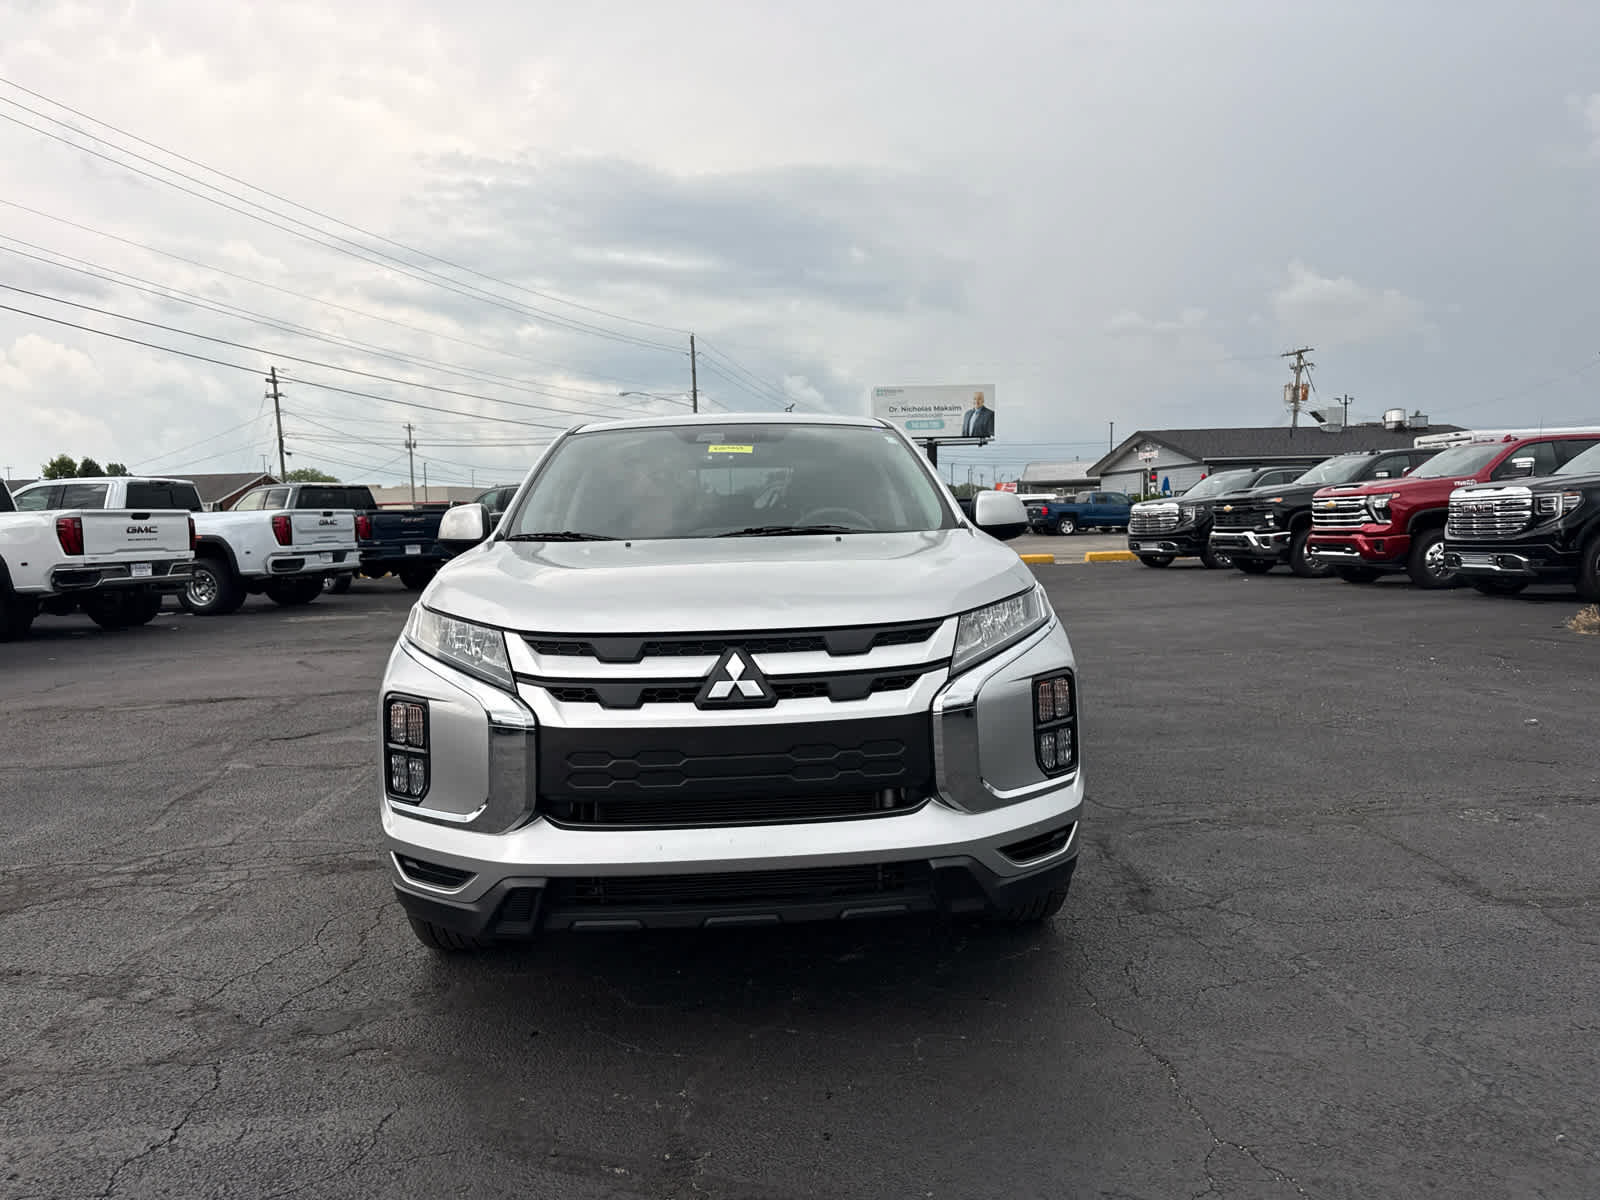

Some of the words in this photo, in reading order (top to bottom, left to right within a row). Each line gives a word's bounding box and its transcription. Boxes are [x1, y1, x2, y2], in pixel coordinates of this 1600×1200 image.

[933, 404, 962, 412] Maksim
[1462, 503, 1493, 513] GMC
[319, 518, 338, 526] GMC
[126, 525, 159, 534] GMC
